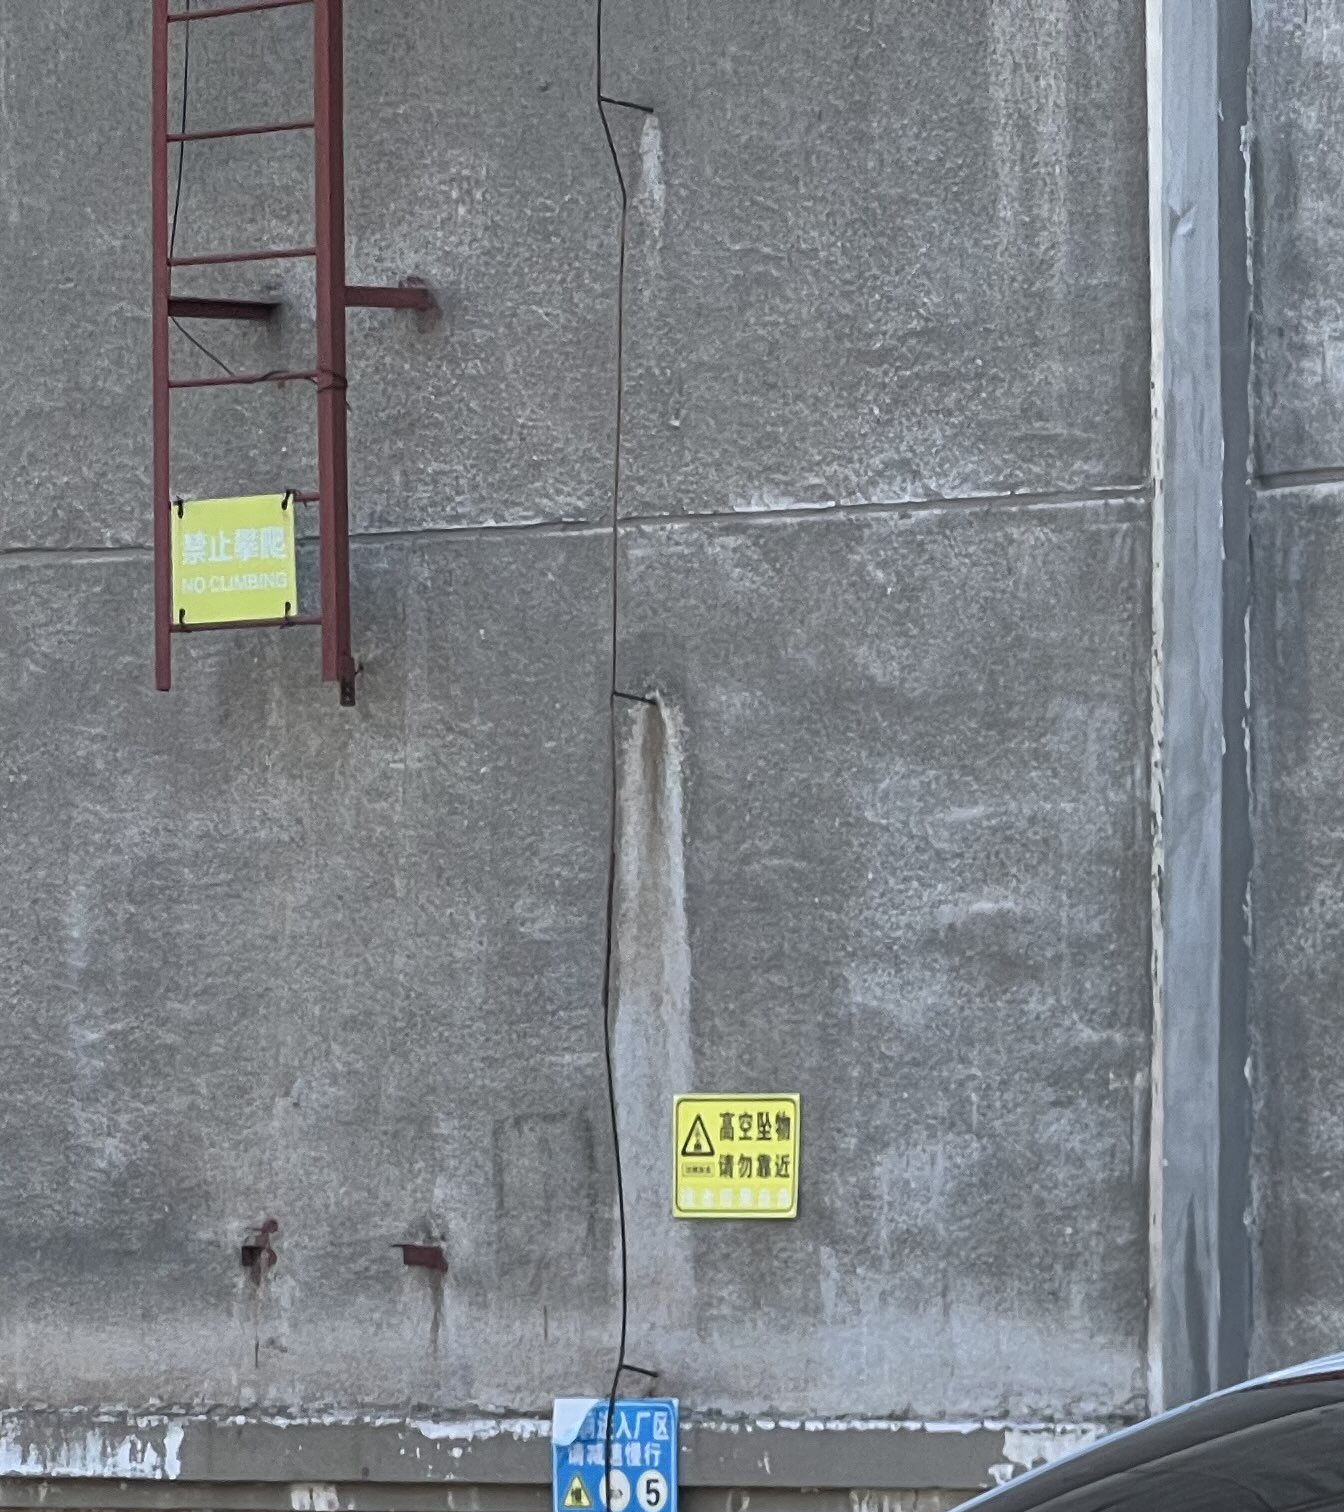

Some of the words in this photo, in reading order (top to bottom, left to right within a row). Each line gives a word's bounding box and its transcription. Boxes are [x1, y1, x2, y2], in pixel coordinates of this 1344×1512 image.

[182, 526, 287, 566] 禁止攀爬
[182, 576, 206, 593] NO
[210, 571, 288, 593] CLIMBING
[719, 1111, 791, 1142] 高空坠物
[719, 1153, 790, 1179] 请勿靠近
[645, 1478, 660, 1507] 5
